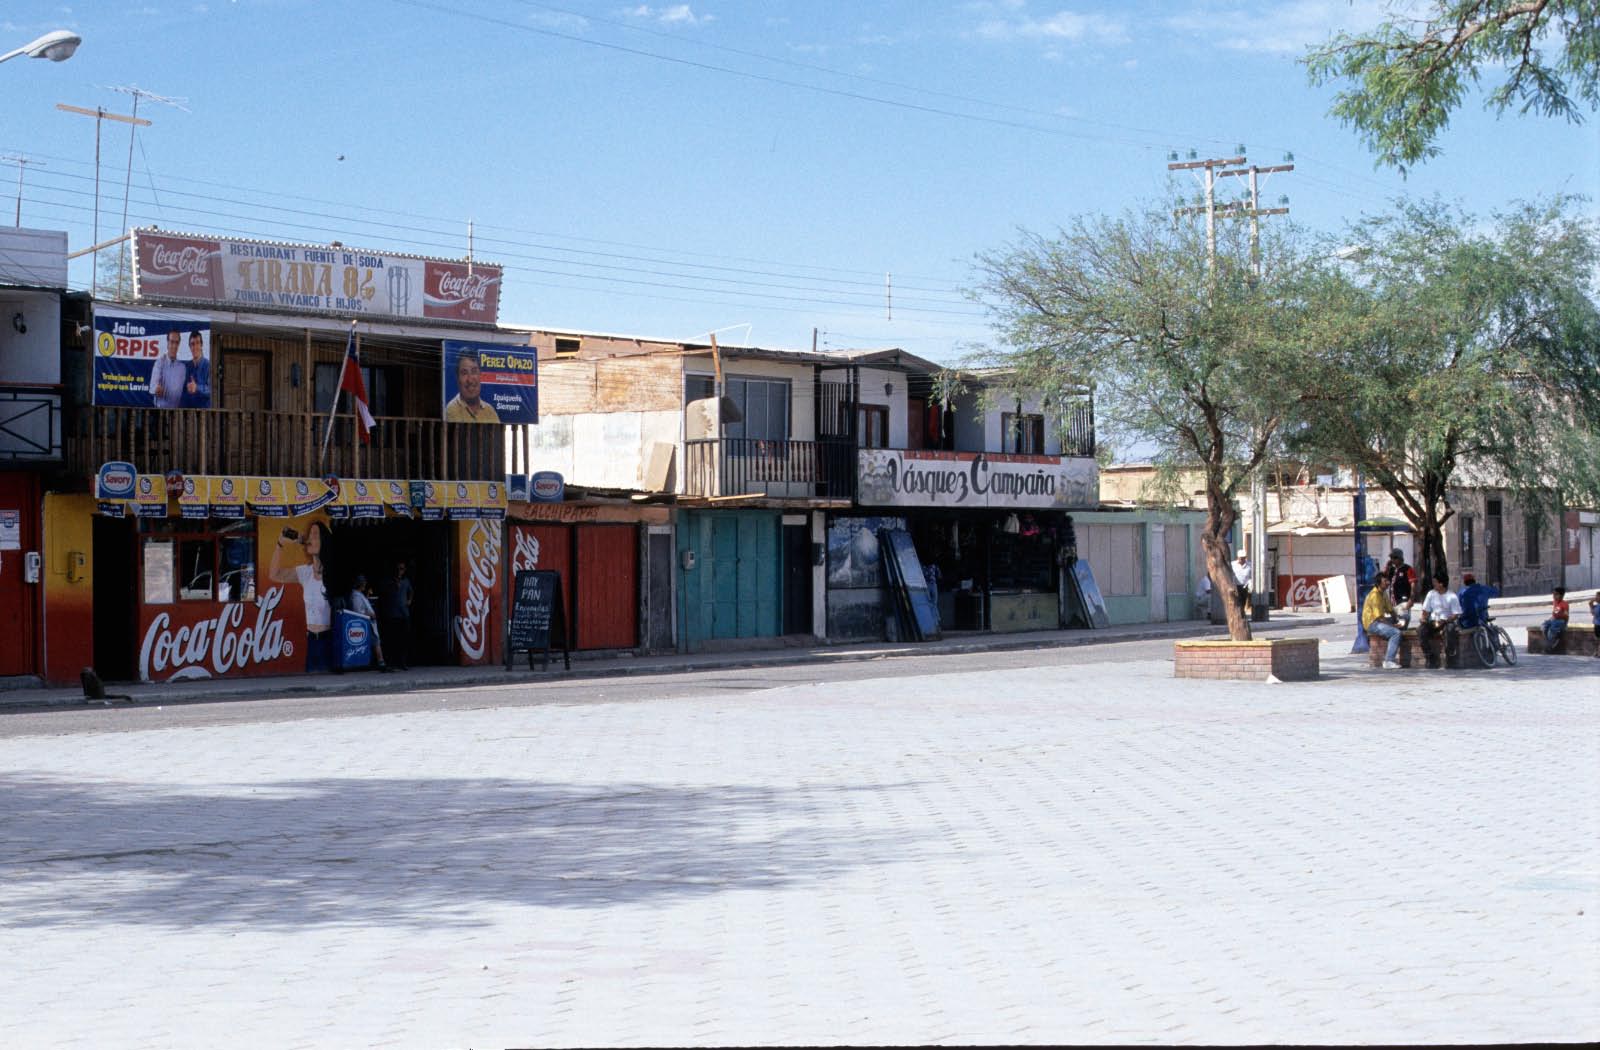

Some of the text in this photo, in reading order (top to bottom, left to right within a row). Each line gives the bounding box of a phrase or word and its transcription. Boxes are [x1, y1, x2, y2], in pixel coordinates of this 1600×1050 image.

[153, 243, 209, 273] Coca-Cola
[230, 243, 384, 269] RESTAURANT FUENTE DE SODA
[238, 259, 333, 297] TIRANA
[439, 271, 488, 299] Coca-Cola
[278, 292, 320, 308] VIVANCO
[325, 296, 331, 308] E
[112, 321, 146, 335] Jaime
[98, 332, 160, 358] ORPIS
[480, 353, 533, 370] PEREZ OPAZO
[105, 473, 131, 485] Savory
[887, 452, 1056, 503] Vásquez Campaña
[521, 589, 541, 601] PAN
[139, 584, 284, 683] Coca-Cola
